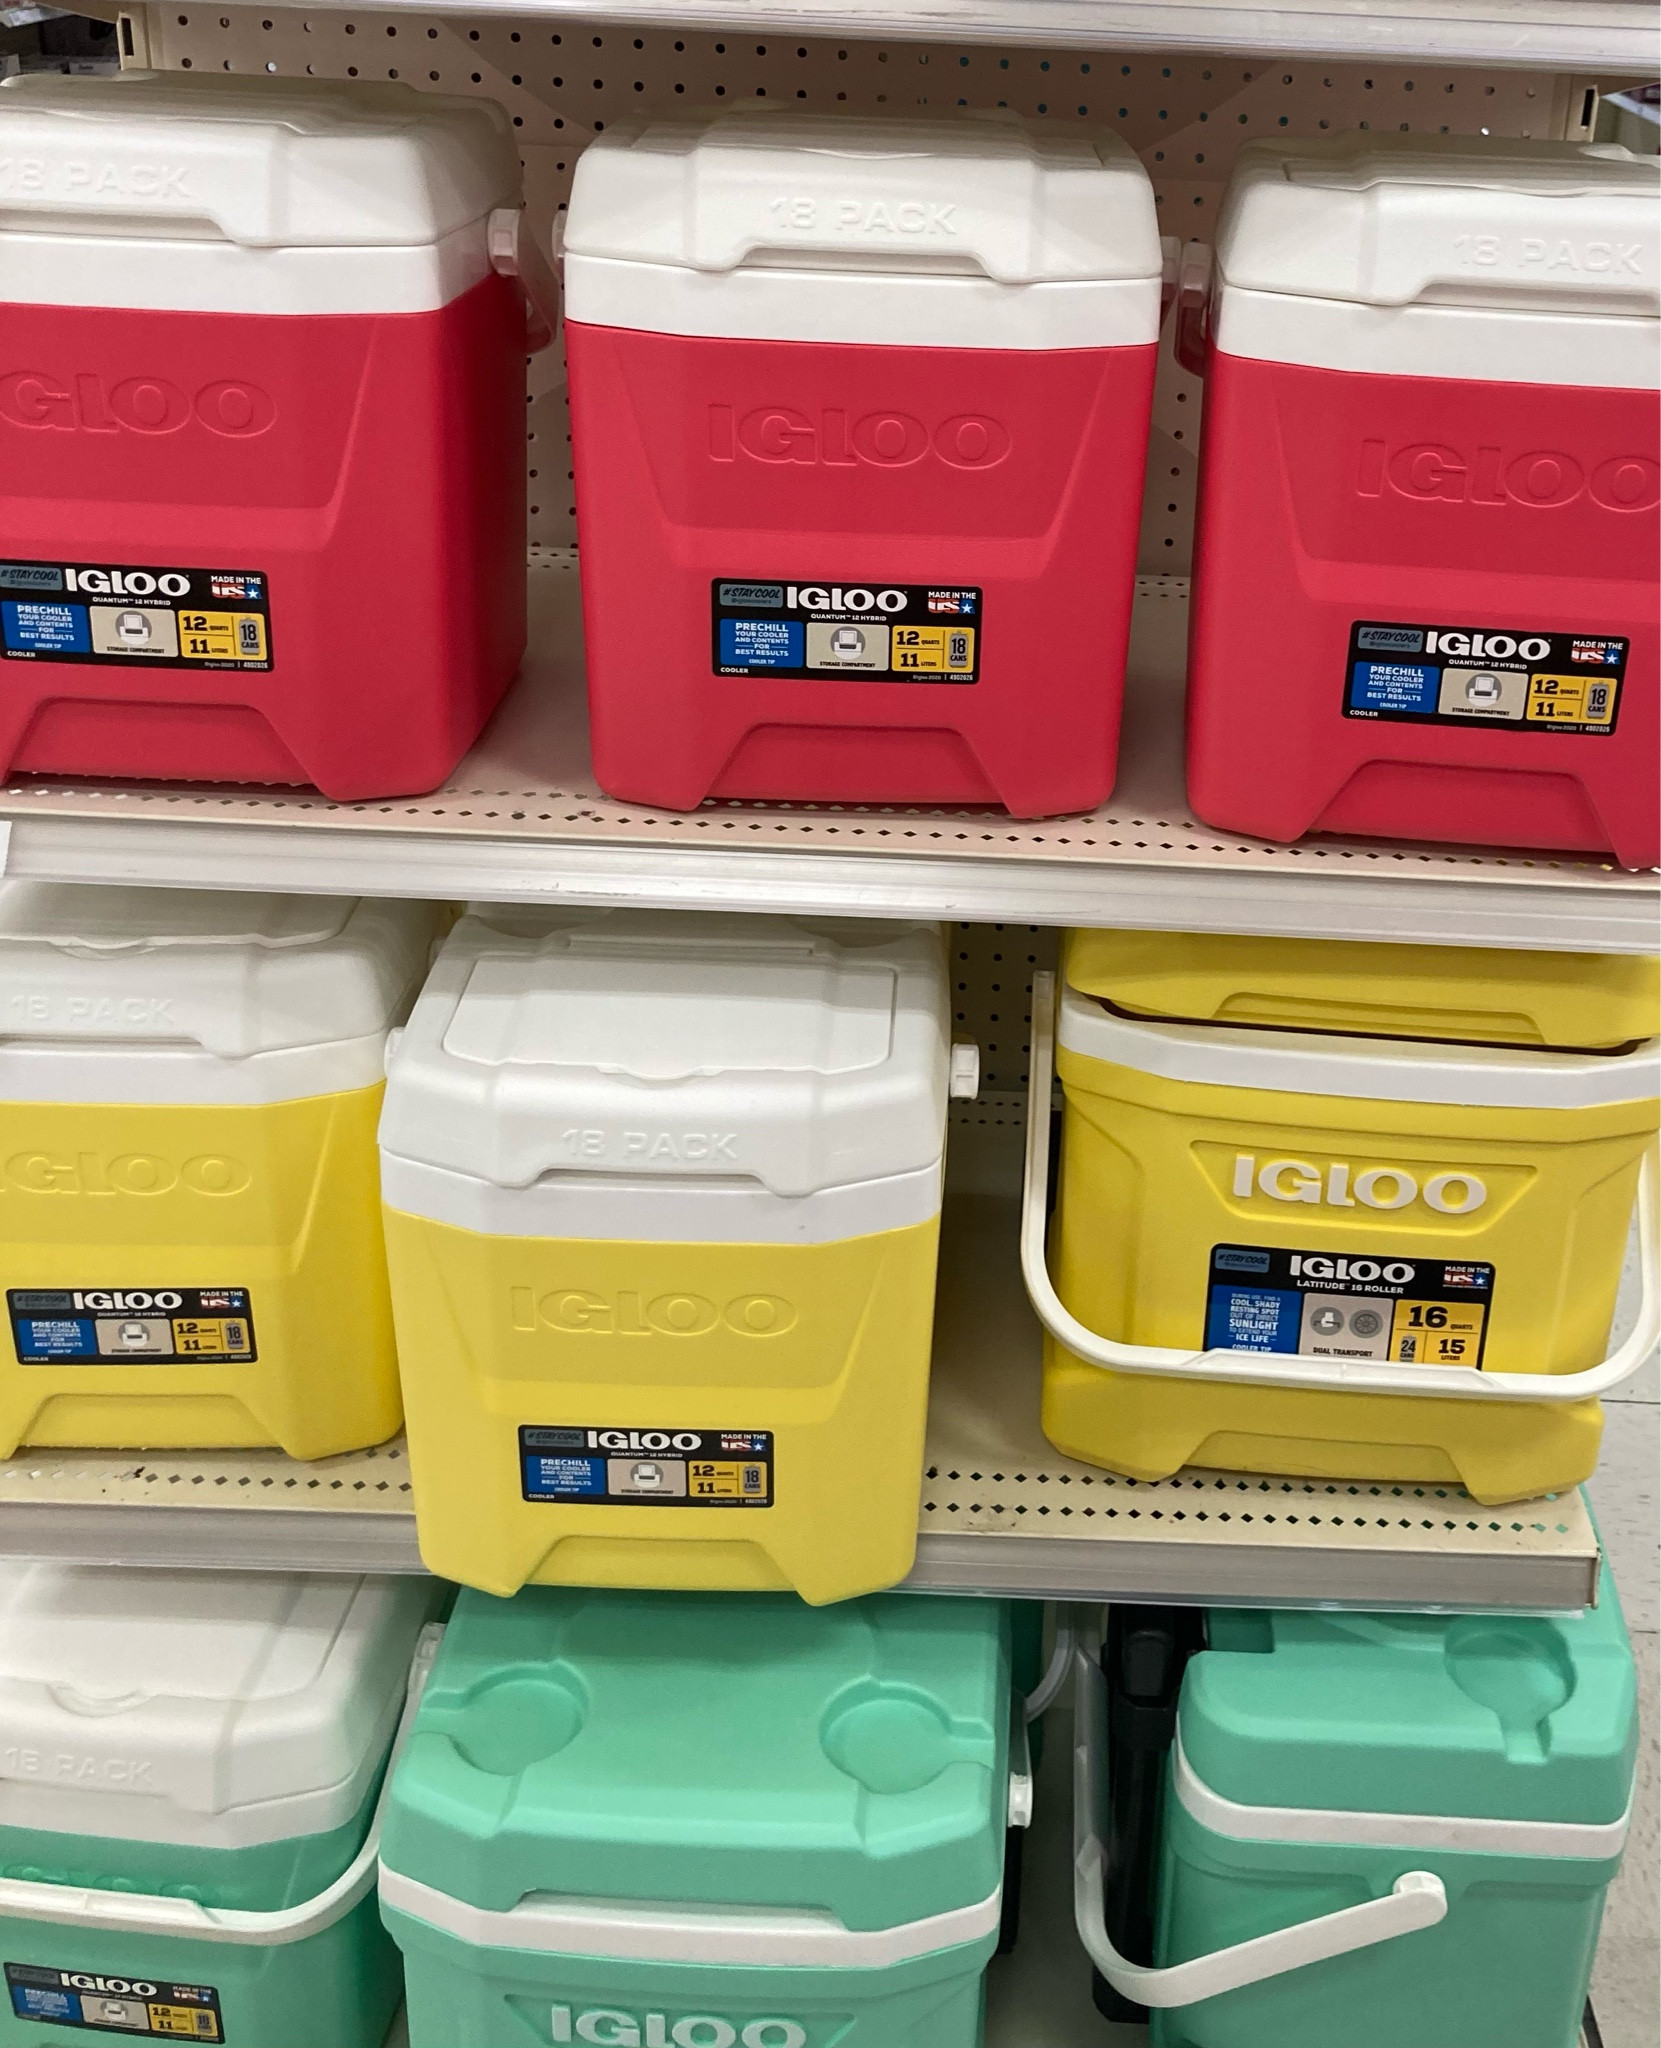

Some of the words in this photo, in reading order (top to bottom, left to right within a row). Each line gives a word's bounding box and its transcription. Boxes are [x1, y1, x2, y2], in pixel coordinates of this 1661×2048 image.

[66, 161, 191, 198] PACK
[770, 197, 817, 229] 18
[836, 200, 957, 235] PACK
[1453, 234, 1501, 266] 18
[1517, 238, 1643, 274] PACK
[707, 403, 1012, 470] IGLOO
[1357, 438, 1661, 513] IGLOO
[65, 568, 191, 597] IGLOO
[245, 577, 261, 585] THE
[211, 583, 263, 599] USA
[787, 586, 908, 613] IGLOO
[928, 599, 976, 614] USA
[17, 605, 72, 616] PRECHILL
[182, 616, 208, 631] 12
[735, 622, 789, 632] PRECHILL
[41, 633, 75, 641] RESULTS
[241, 624, 257, 641] 18
[896, 631, 920, 646] 12
[190, 639, 210, 654] 11
[951, 638, 966, 654] 18
[1426, 631, 1550, 660] IGLOO
[1572, 640, 1596, 648] MADE
[1597, 641, 1606, 649] IN
[1607, 642, 1623, 650] THE
[900, 653, 919, 667] 11
[1571, 648, 1620, 664] USA
[1370, 665, 1424, 677] PRECHILL
[1500, 662, 1527, 670] HYBRID
[1385, 681, 1423, 689] CONTENTS
[1392, 675, 1424, 683] COOLER
[1534, 679, 1559, 694] 12
[1388, 693, 1421, 701] RESULTS
[1591, 689, 1607, 706] 18
[1535, 702, 1555, 717] 11
[1588, 705, 1606, 713] CANS
[10, 996, 49, 1021] 18
[69, 997, 174, 1025] PACK
[562, 1129, 605, 1156] 18
[624, 1131, 738, 1160] PACK
[1233, 1153, 1487, 1214] IGLOO
[1290, 1255, 1415, 1283] IGLOO
[1364, 1285, 1404, 1294] ROLLER
[73, 1291, 183, 1310] IGLOO
[1255, 1300, 1280, 1309] SHADY
[510, 1286, 798, 1337] IGLOO
[1230, 1305, 1260, 1314] RESTING
[1408, 1305, 1449, 1328] 16
[177, 1322, 198, 1334] 12
[1229, 1319, 1279, 1330] SUNLIGHT
[227, 1326, 241, 1339] 18
[1236, 1333, 1249, 1342] ICE
[1251, 1335, 1269, 1343] LIFE
[183, 1339, 201, 1351] 11
[1333, 1348, 1373, 1357] TRANSPORT
[1401, 1340, 1416, 1352] 24
[1439, 1338, 1466, 1354] 15
[587, 1431, 702, 1451] IGLOO
[541, 1458, 591, 1467] PRECHILL
[693, 1465, 715, 1477] 12
[745, 1470, 759, 1483] 18
[697, 1482, 715, 1493] 11
[60, 1973, 158, 1996] IGLOO
[152, 2007, 171, 2016] 12
[158, 2020, 173, 2030] 11
[551, 2004, 807, 2048] IGLOO
